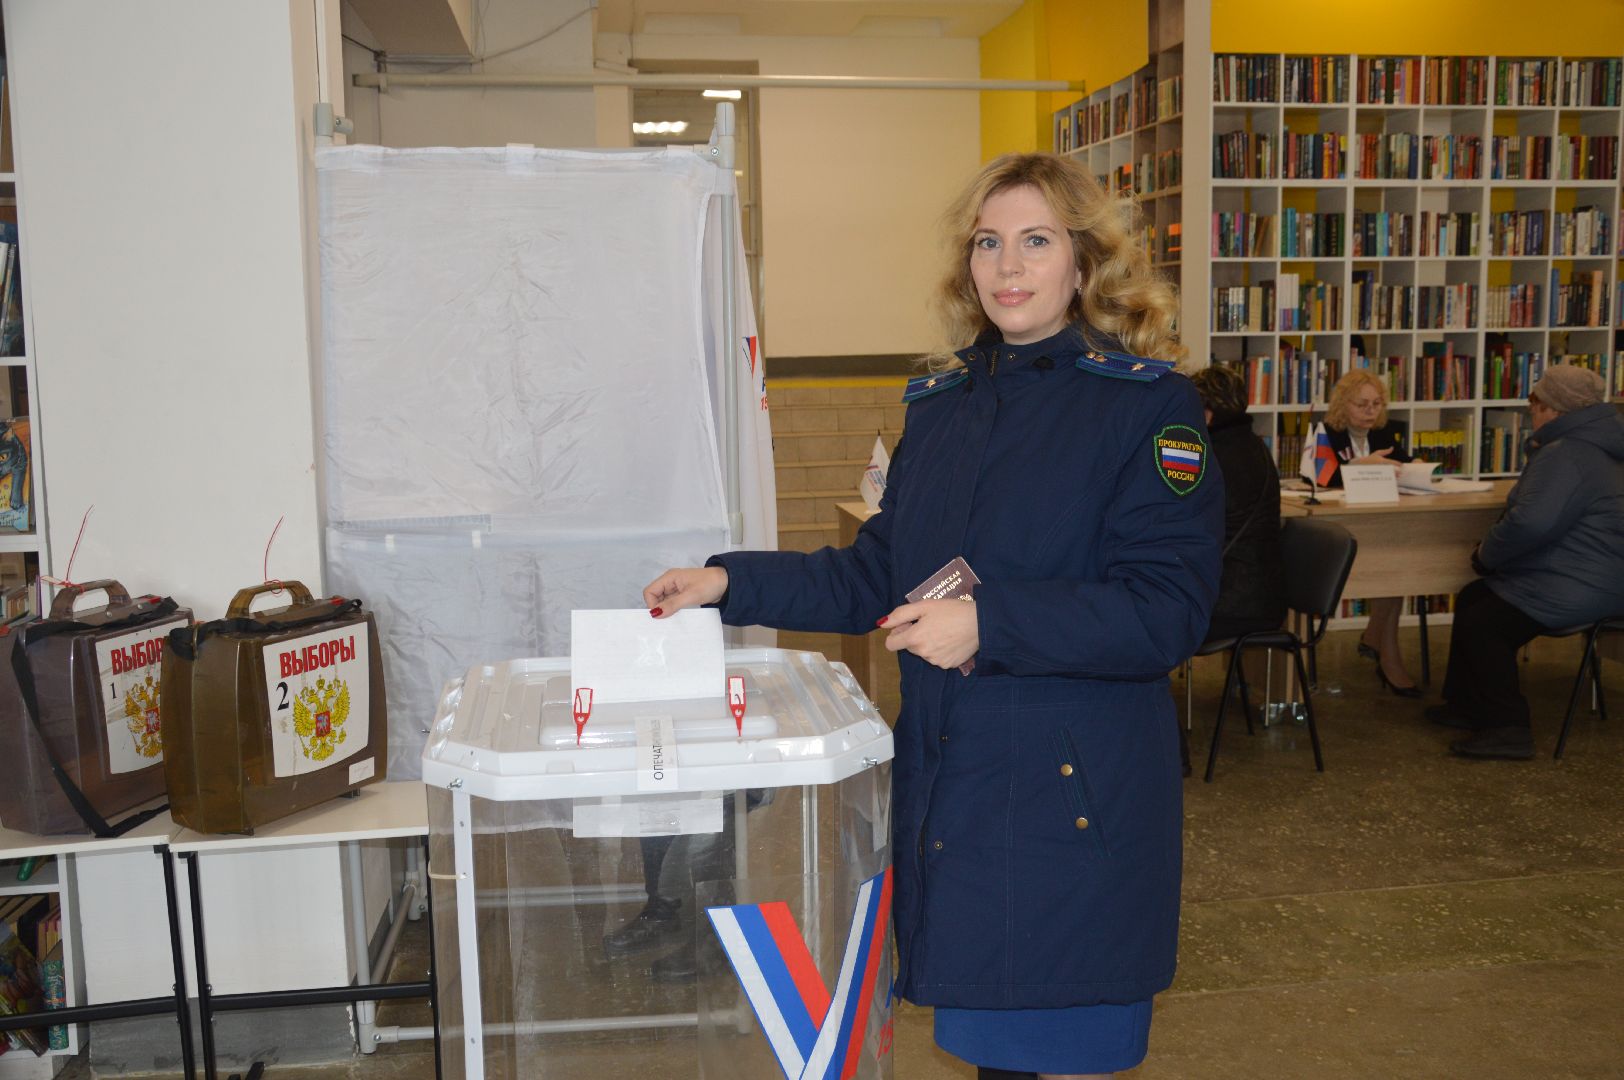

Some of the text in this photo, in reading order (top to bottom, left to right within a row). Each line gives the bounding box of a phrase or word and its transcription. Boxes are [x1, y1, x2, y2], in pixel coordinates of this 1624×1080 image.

[1158, 439, 1203, 453] ПРОКУРАТУРА
[1167, 470, 1195, 482] РОССИИ
[111, 638, 163, 675] ВЫБОР
[280, 636, 356, 678] ВЫБОРЫ
[109, 682, 117, 699] 1
[275, 681, 290, 711] 2
